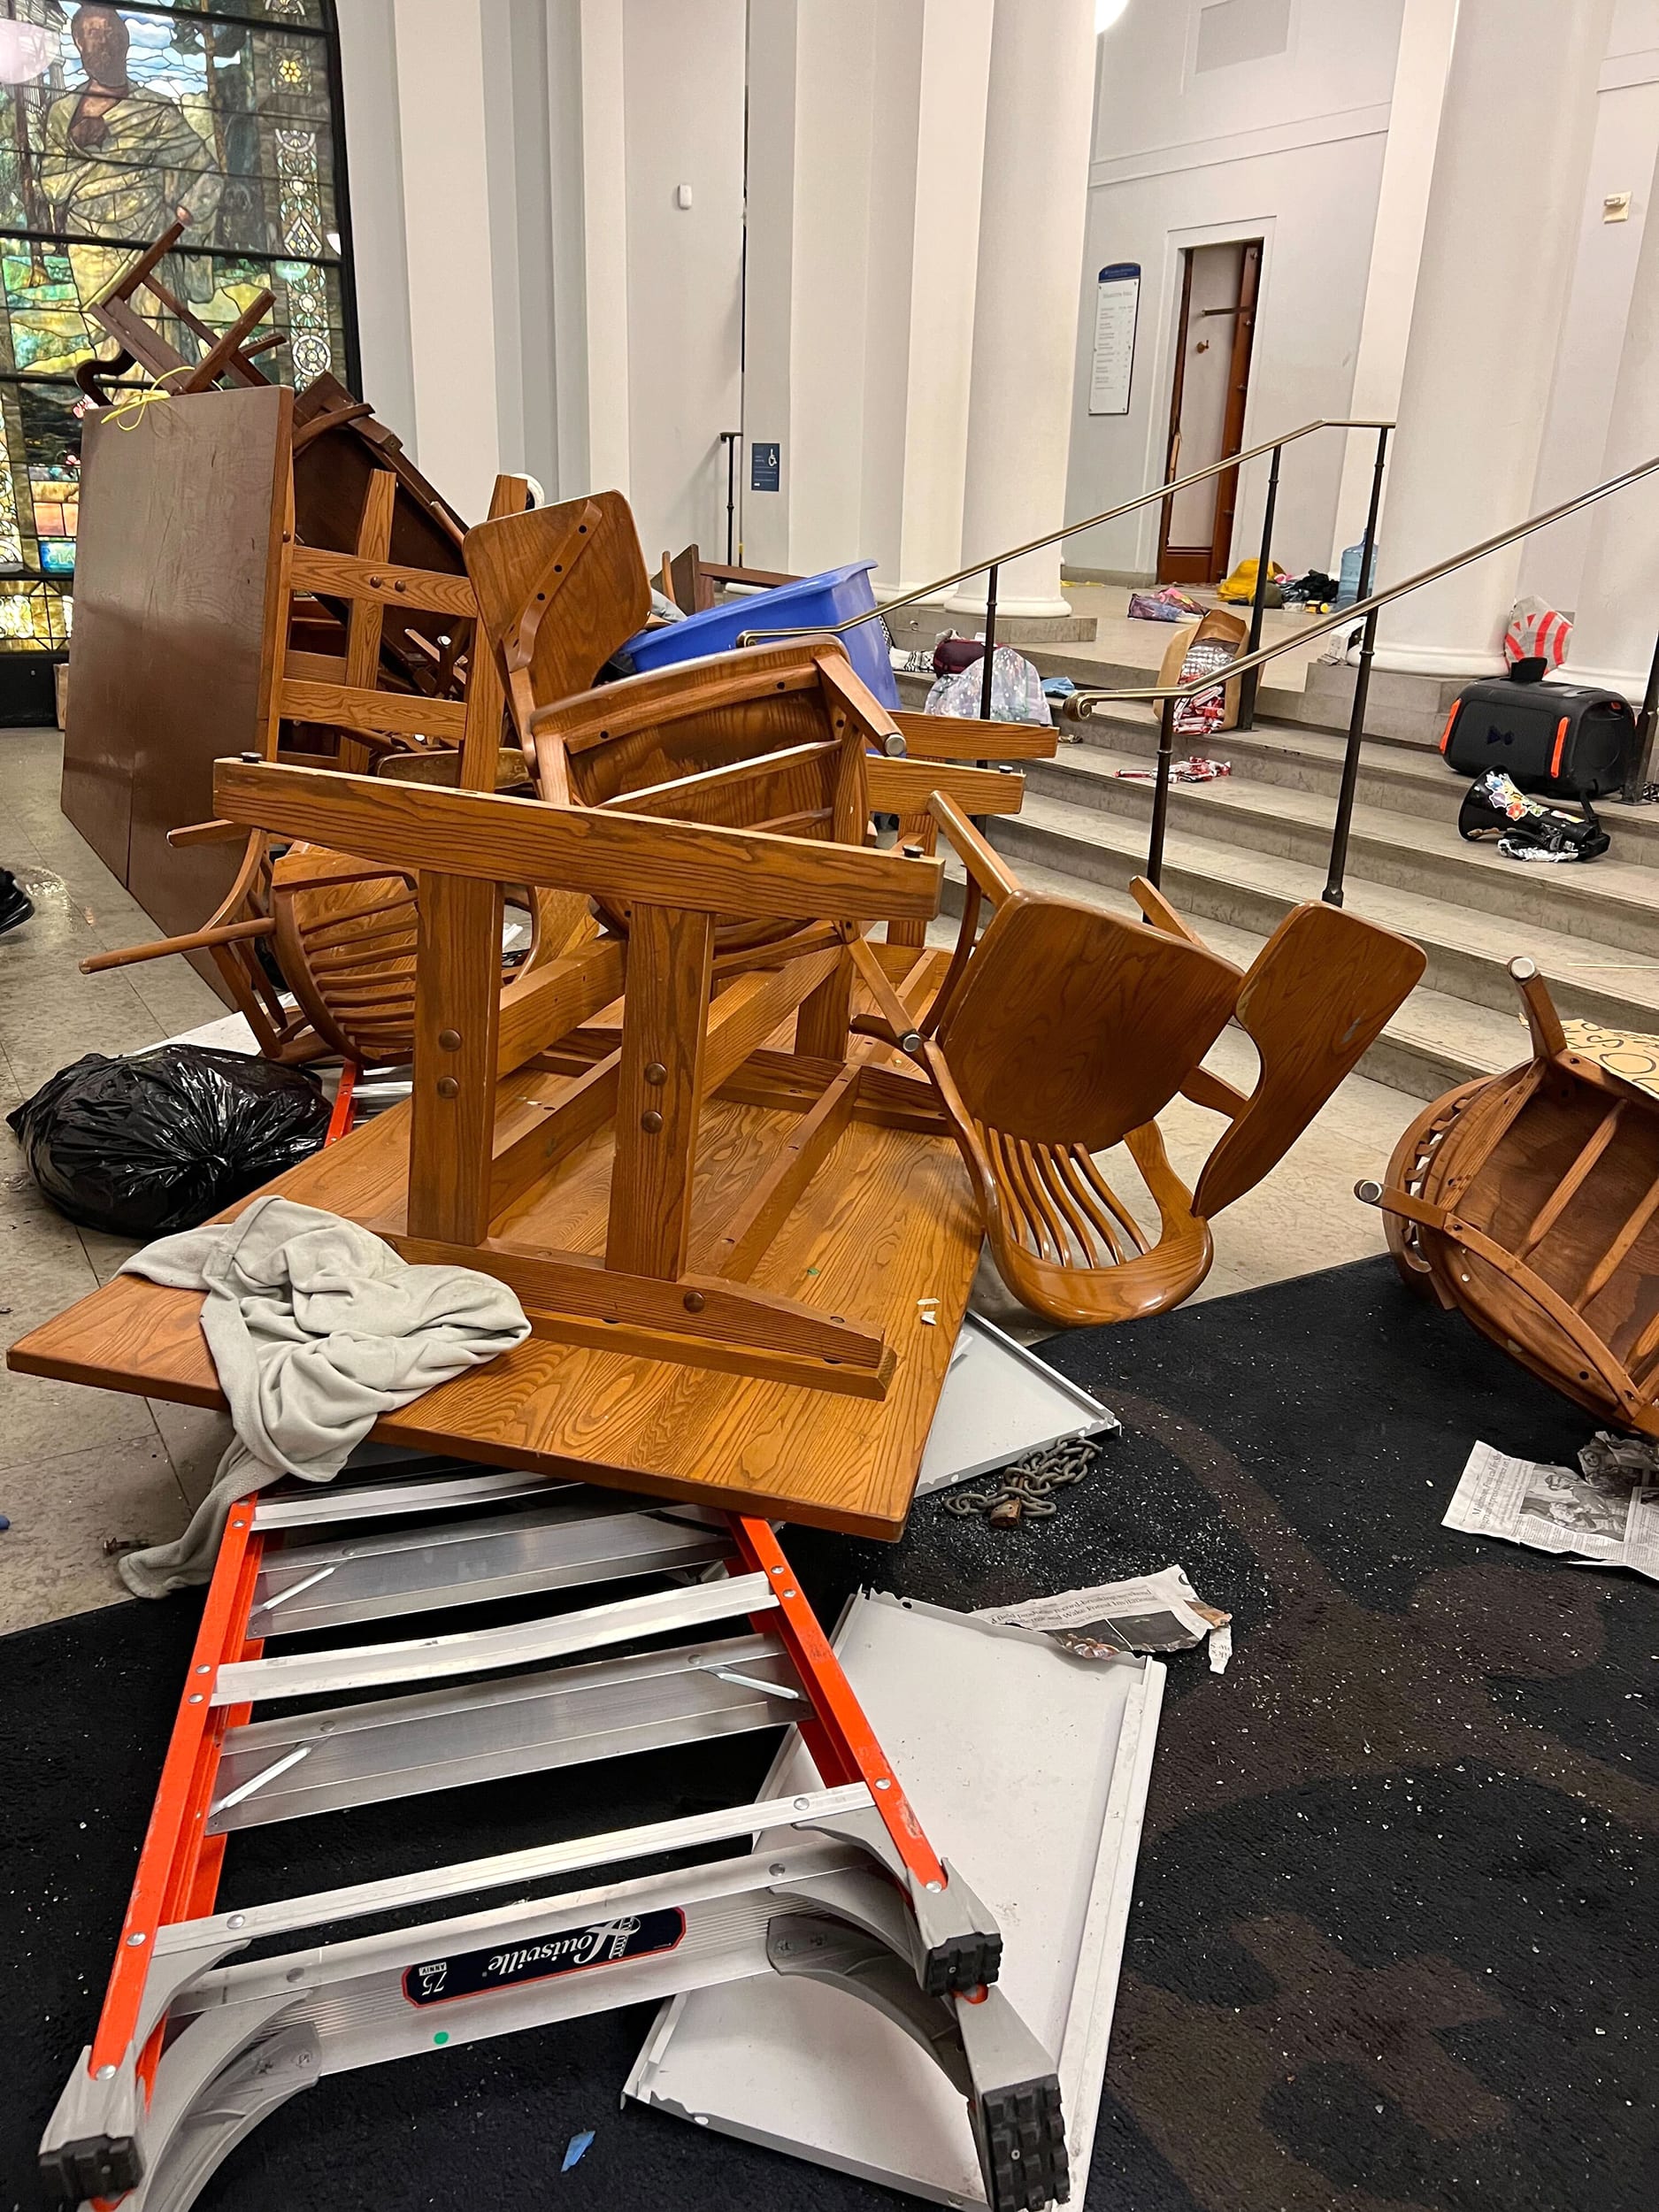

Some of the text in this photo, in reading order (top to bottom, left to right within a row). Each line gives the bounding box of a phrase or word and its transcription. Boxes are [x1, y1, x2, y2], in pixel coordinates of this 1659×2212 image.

[1063, 1608, 1086, 1619] Wake
[488, 1916, 641, 1976] Louisville
[421, 1970, 446, 1996] 75
